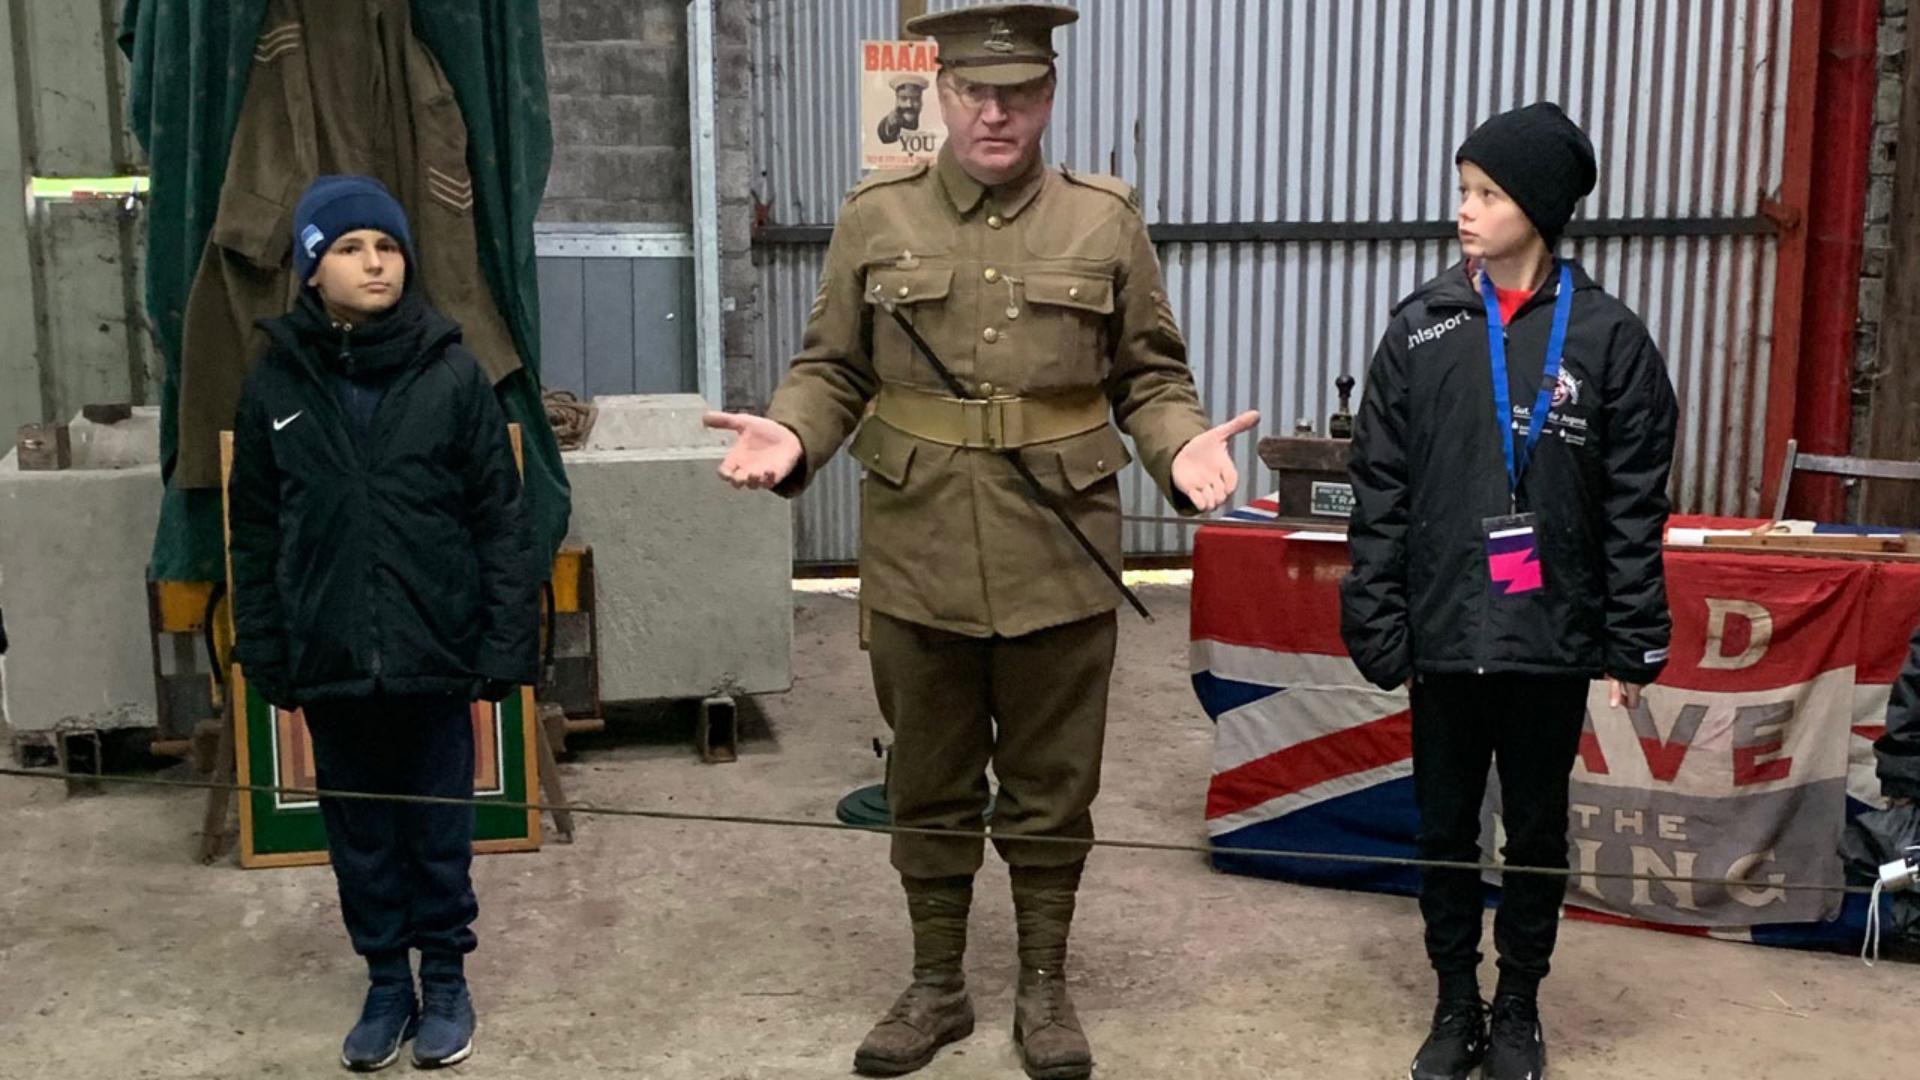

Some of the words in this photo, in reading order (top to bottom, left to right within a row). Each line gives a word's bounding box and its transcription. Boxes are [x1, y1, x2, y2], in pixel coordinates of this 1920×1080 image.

[900, 134, 935, 152] YOU
[1407, 309, 1472, 350] hlsport
[1572, 804, 1687, 840] THE
[1573, 838, 1788, 911] ING
